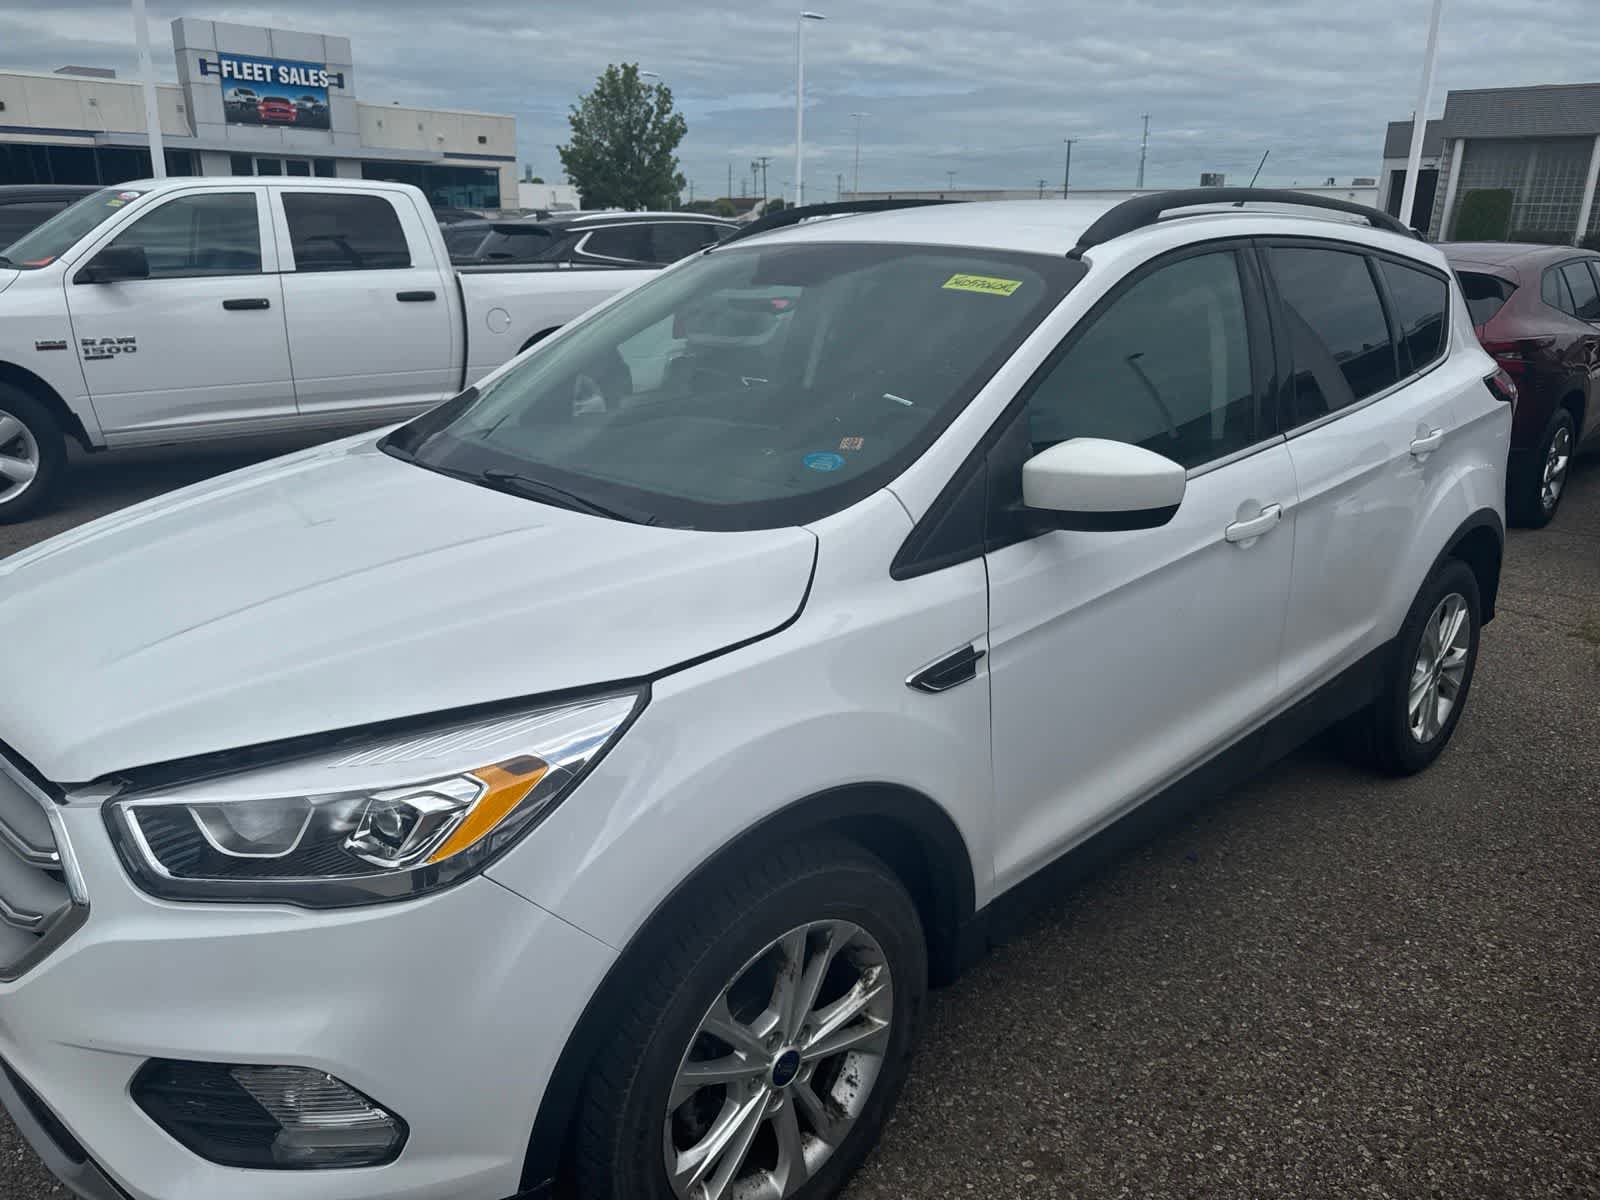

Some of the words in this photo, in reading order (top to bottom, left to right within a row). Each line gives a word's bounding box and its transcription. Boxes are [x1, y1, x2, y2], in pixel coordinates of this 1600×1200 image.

[220, 59, 274, 82] FLEET
[278, 66, 329, 87] SALES
[81, 337, 136, 345] RAM
[82, 346, 136, 354] 1500
